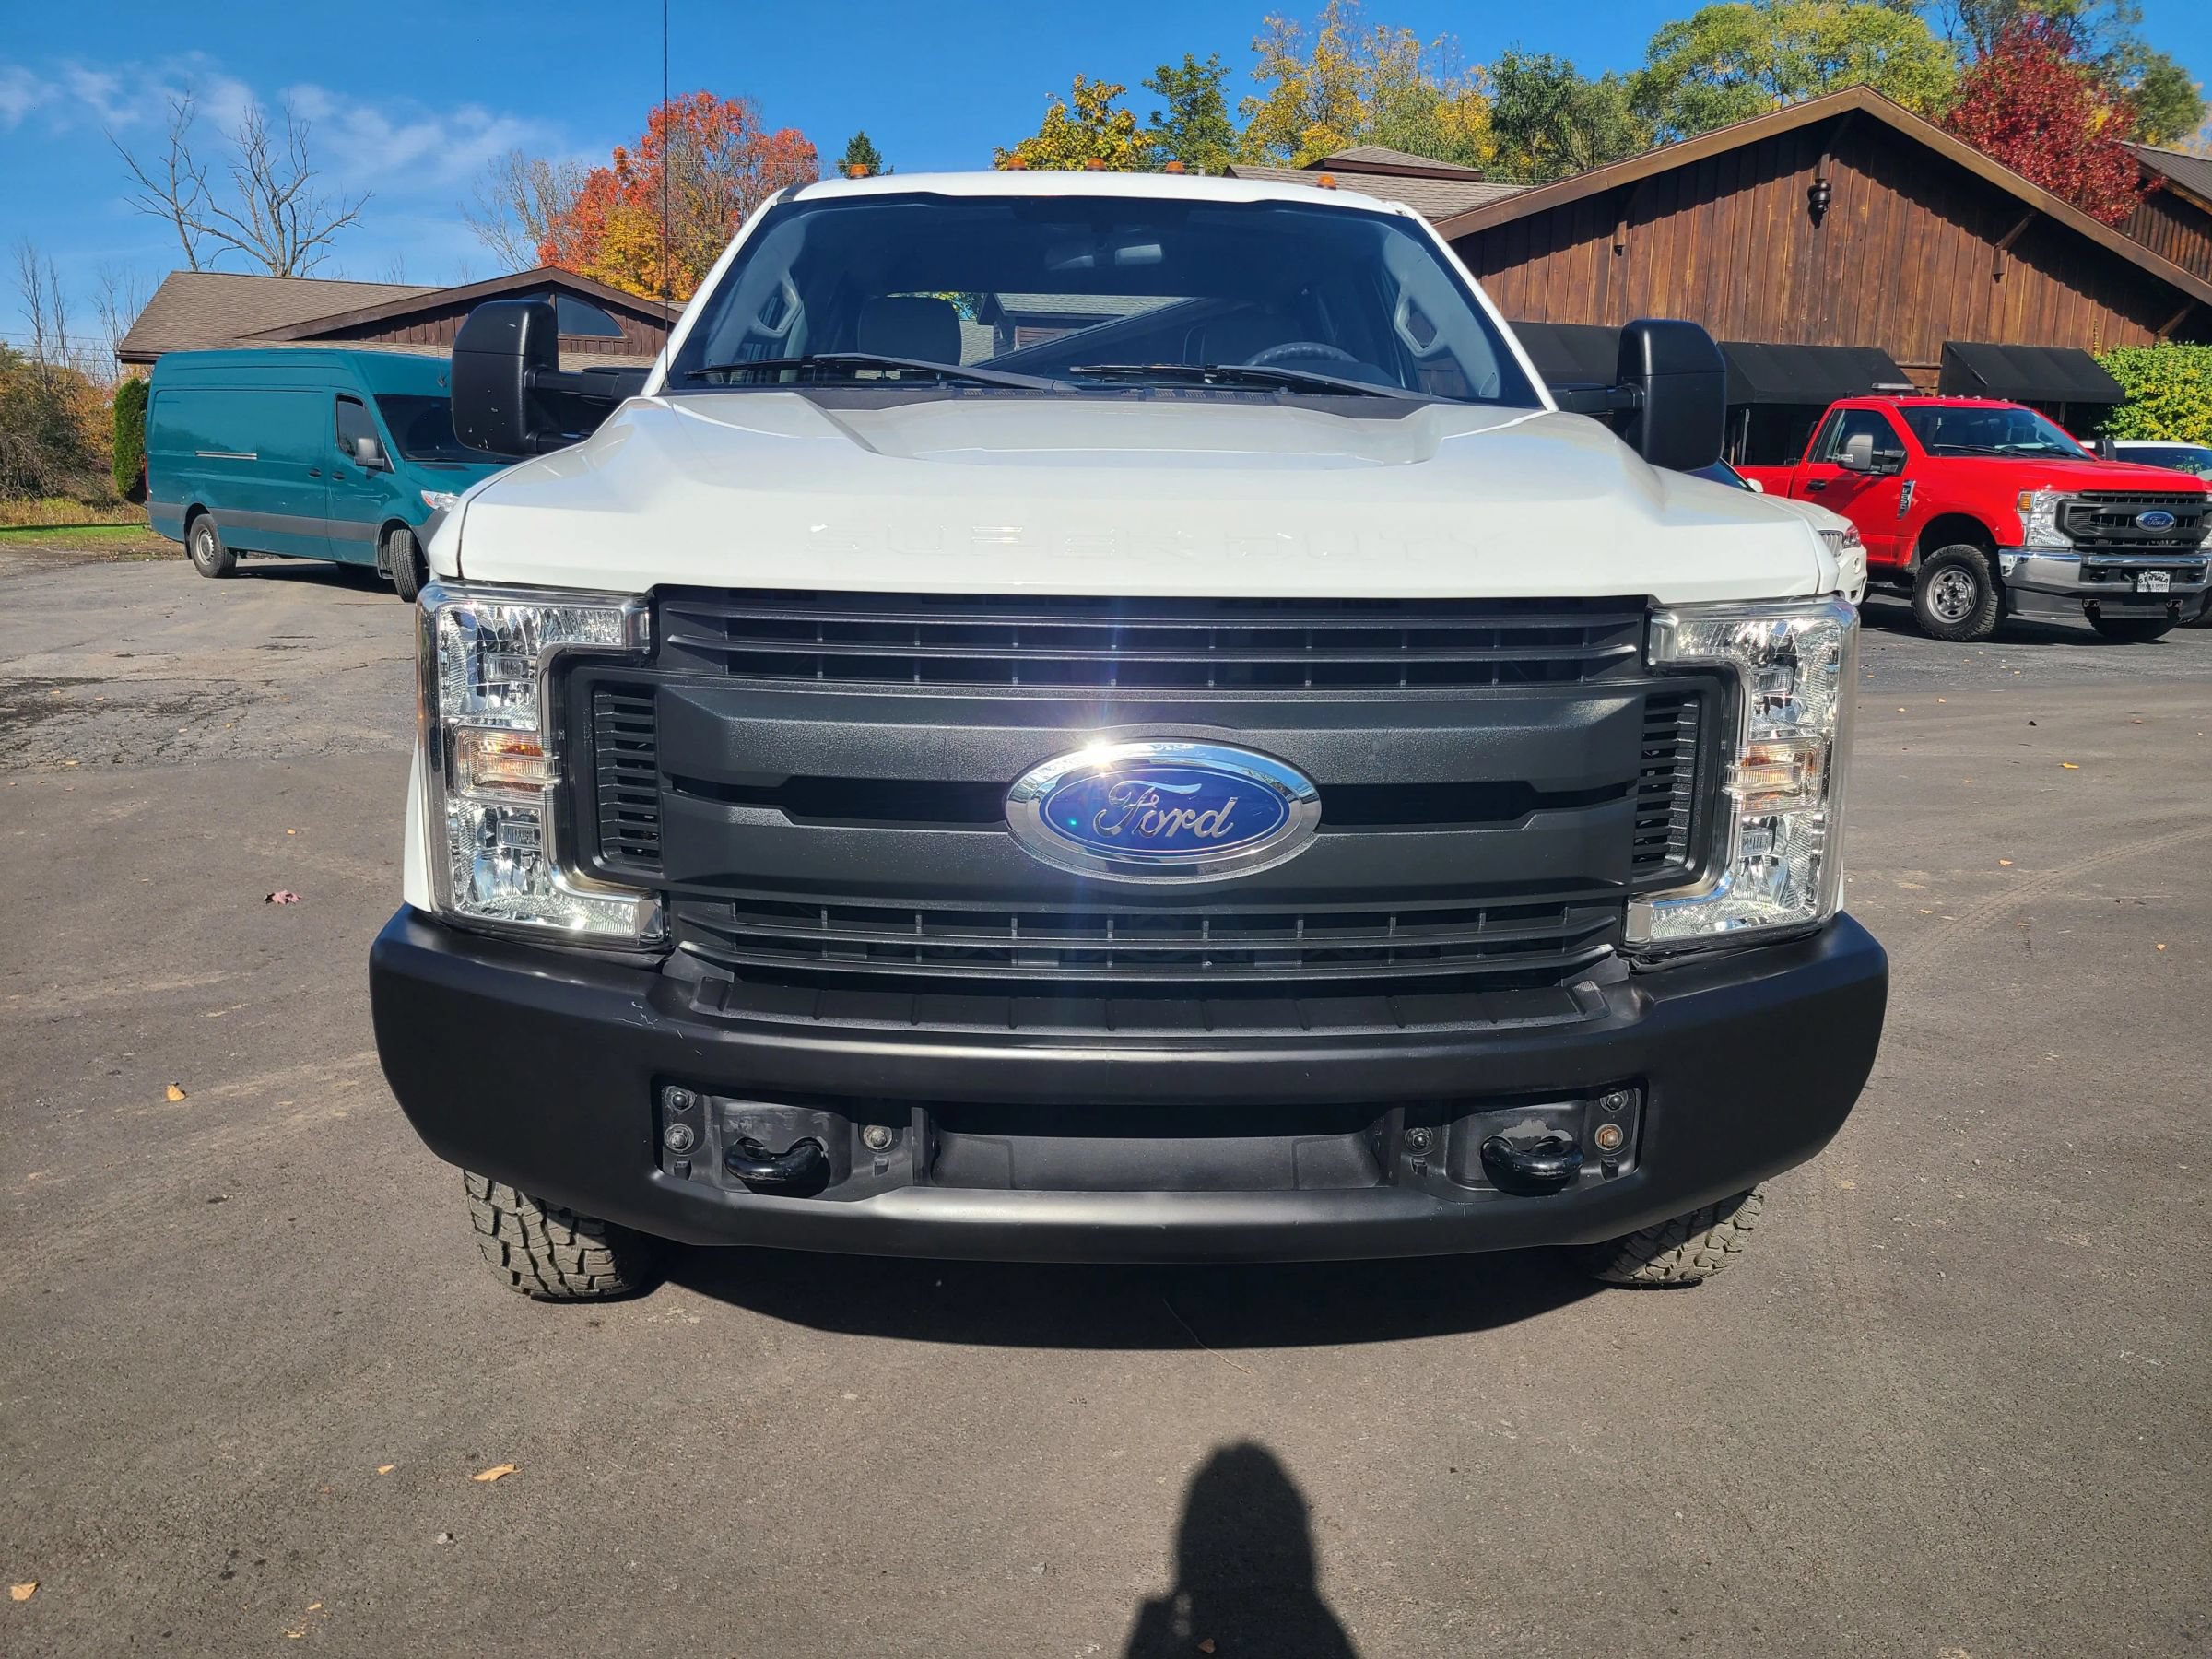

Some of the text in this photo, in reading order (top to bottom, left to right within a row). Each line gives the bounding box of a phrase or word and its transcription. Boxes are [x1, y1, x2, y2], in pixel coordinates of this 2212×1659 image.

[2147, 516, 2165, 525] Ford
[805, 524, 1199, 560] SUPER
[1092, 780, 1239, 839] Ford
